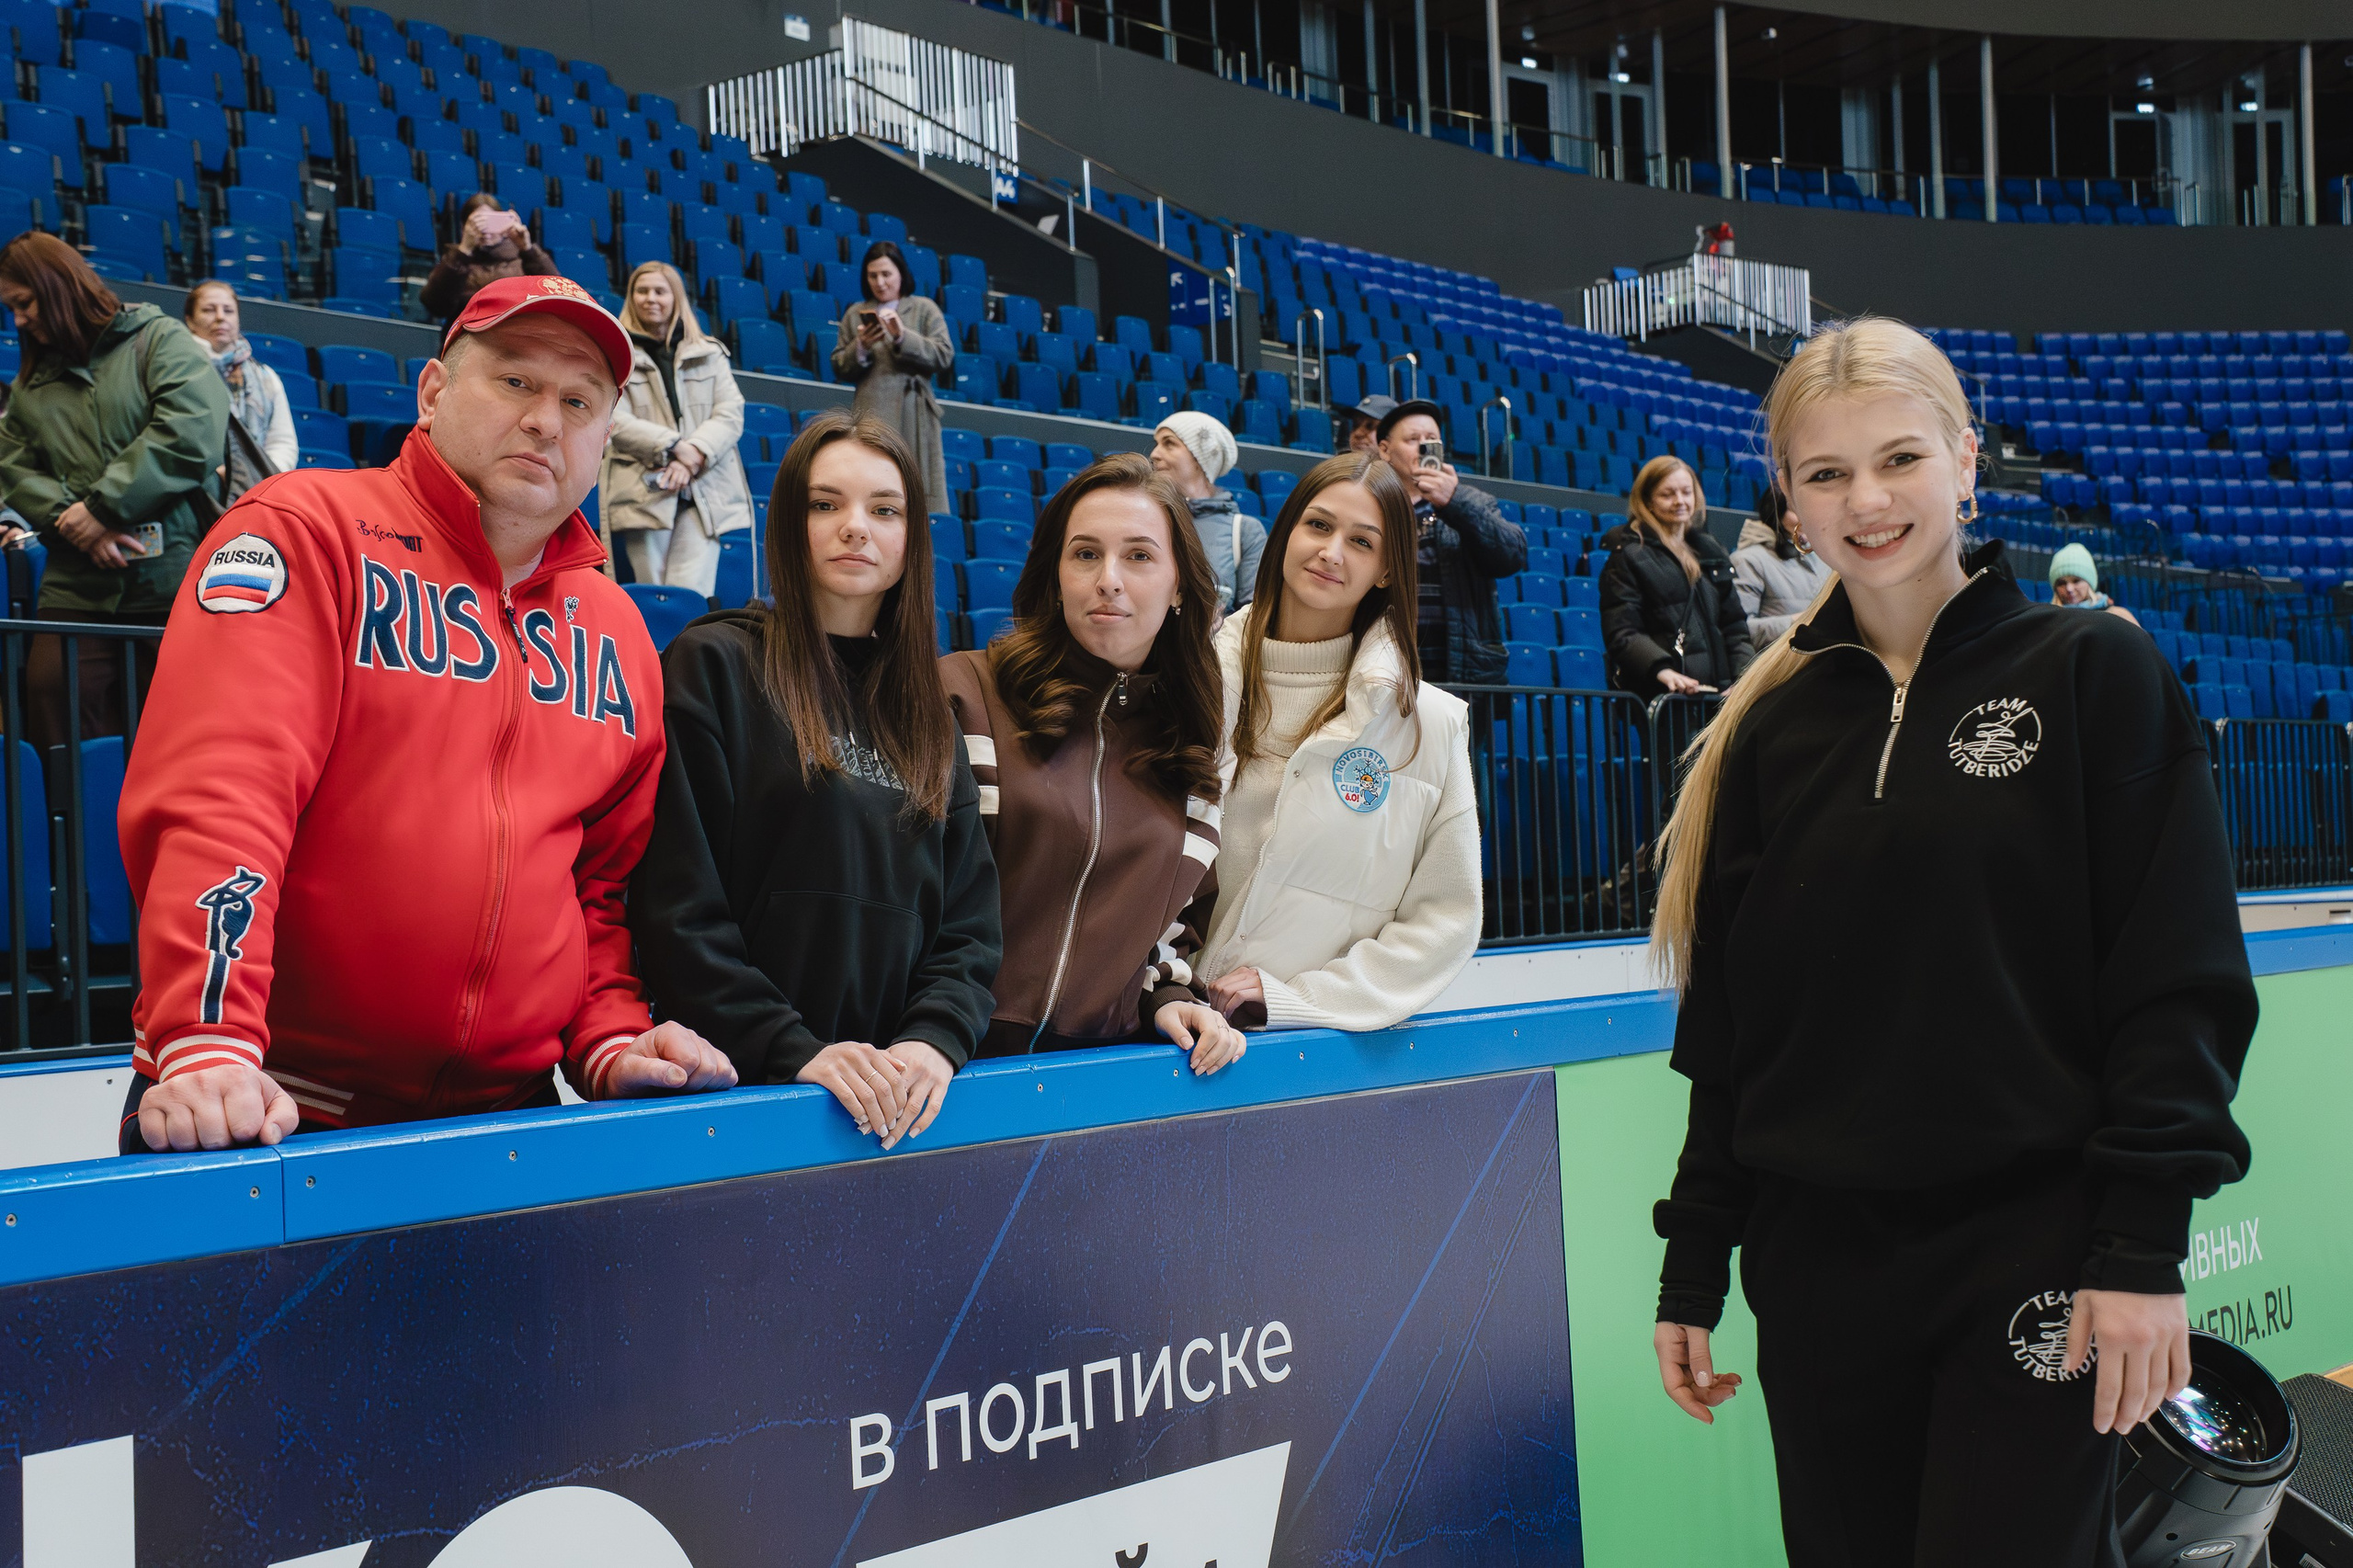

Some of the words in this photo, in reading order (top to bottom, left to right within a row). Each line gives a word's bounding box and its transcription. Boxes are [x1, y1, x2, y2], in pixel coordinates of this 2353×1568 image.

[214, 551, 275, 568] RUSSIA
[355, 553, 636, 739] RUSSIA
[1972, 698, 2028, 715] TEAM
[1948, 738, 2039, 778] TUTBERIDZE
[1340, 784, 1360, 794] CLUB
[1345, 793, 1359, 802] 6.0!
